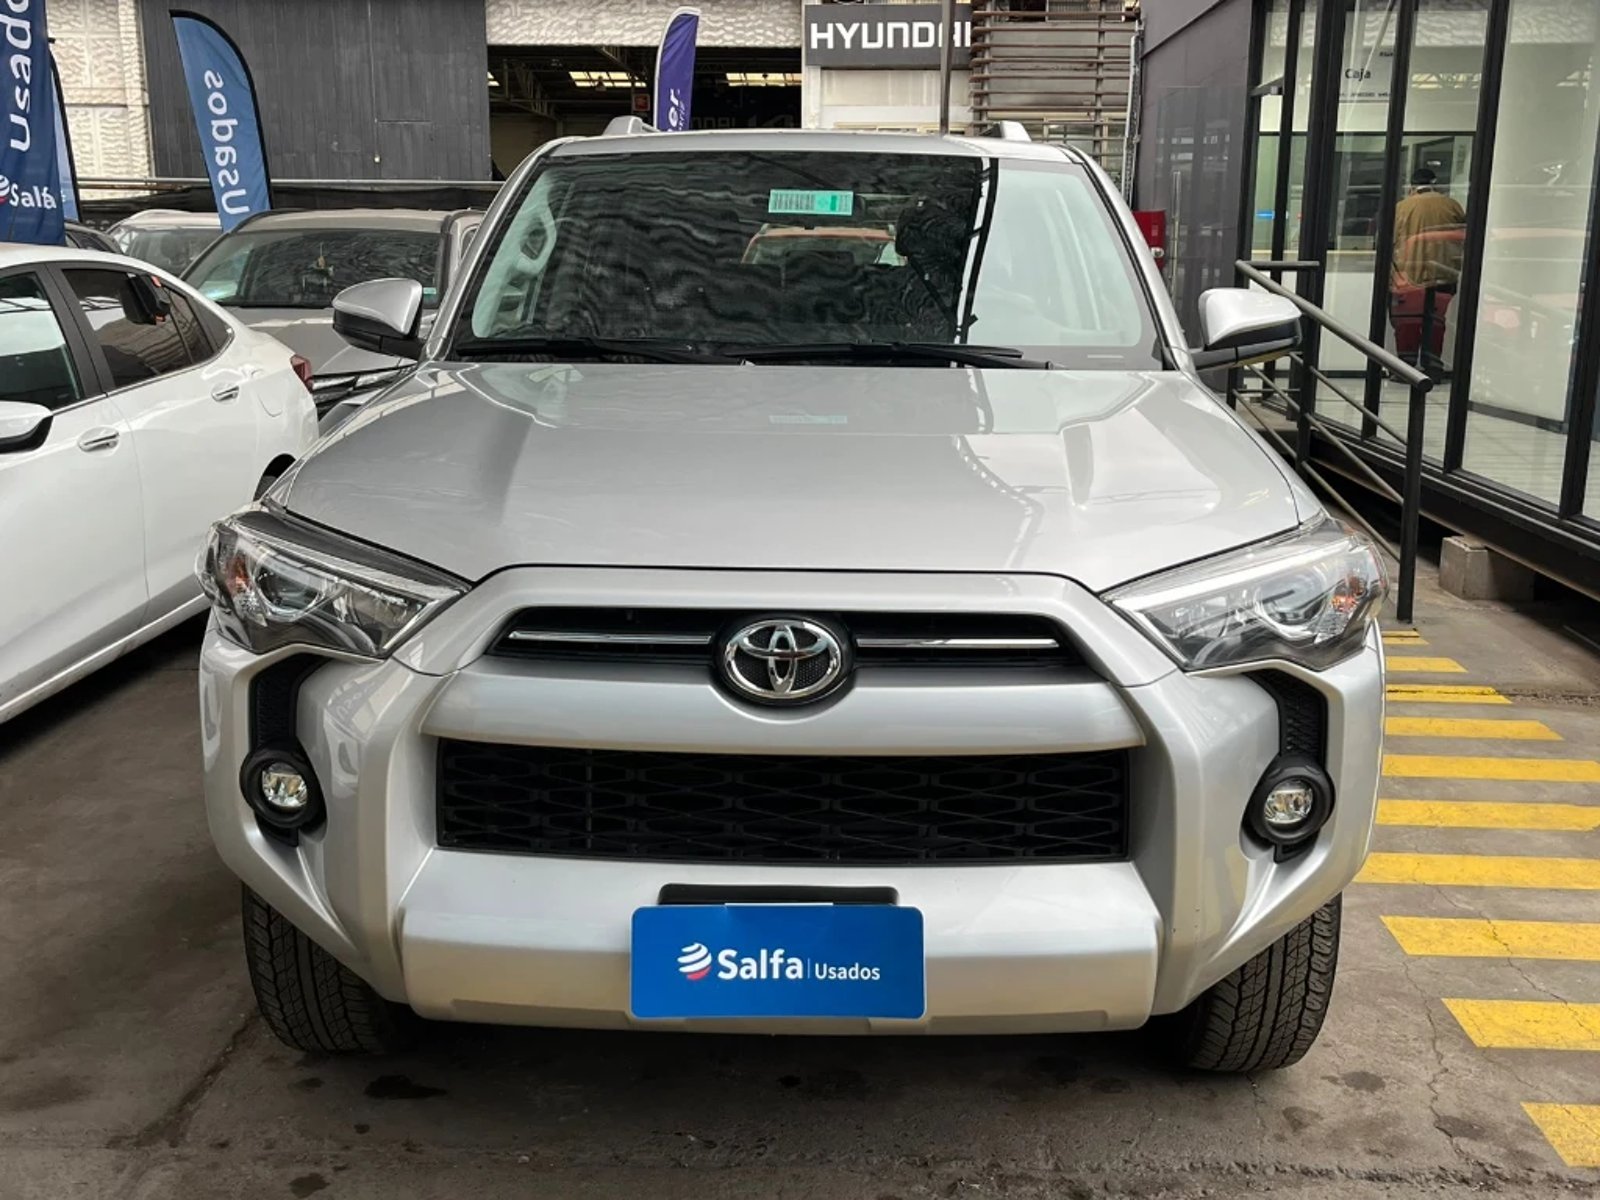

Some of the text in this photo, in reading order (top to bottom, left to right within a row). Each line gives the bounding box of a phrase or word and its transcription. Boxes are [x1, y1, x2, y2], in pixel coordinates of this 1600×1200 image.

[810, 21, 971, 49] HYUNDAI
[1345, 68, 1371, 82] Caja
[717, 948, 881, 980] Salfa Usados
